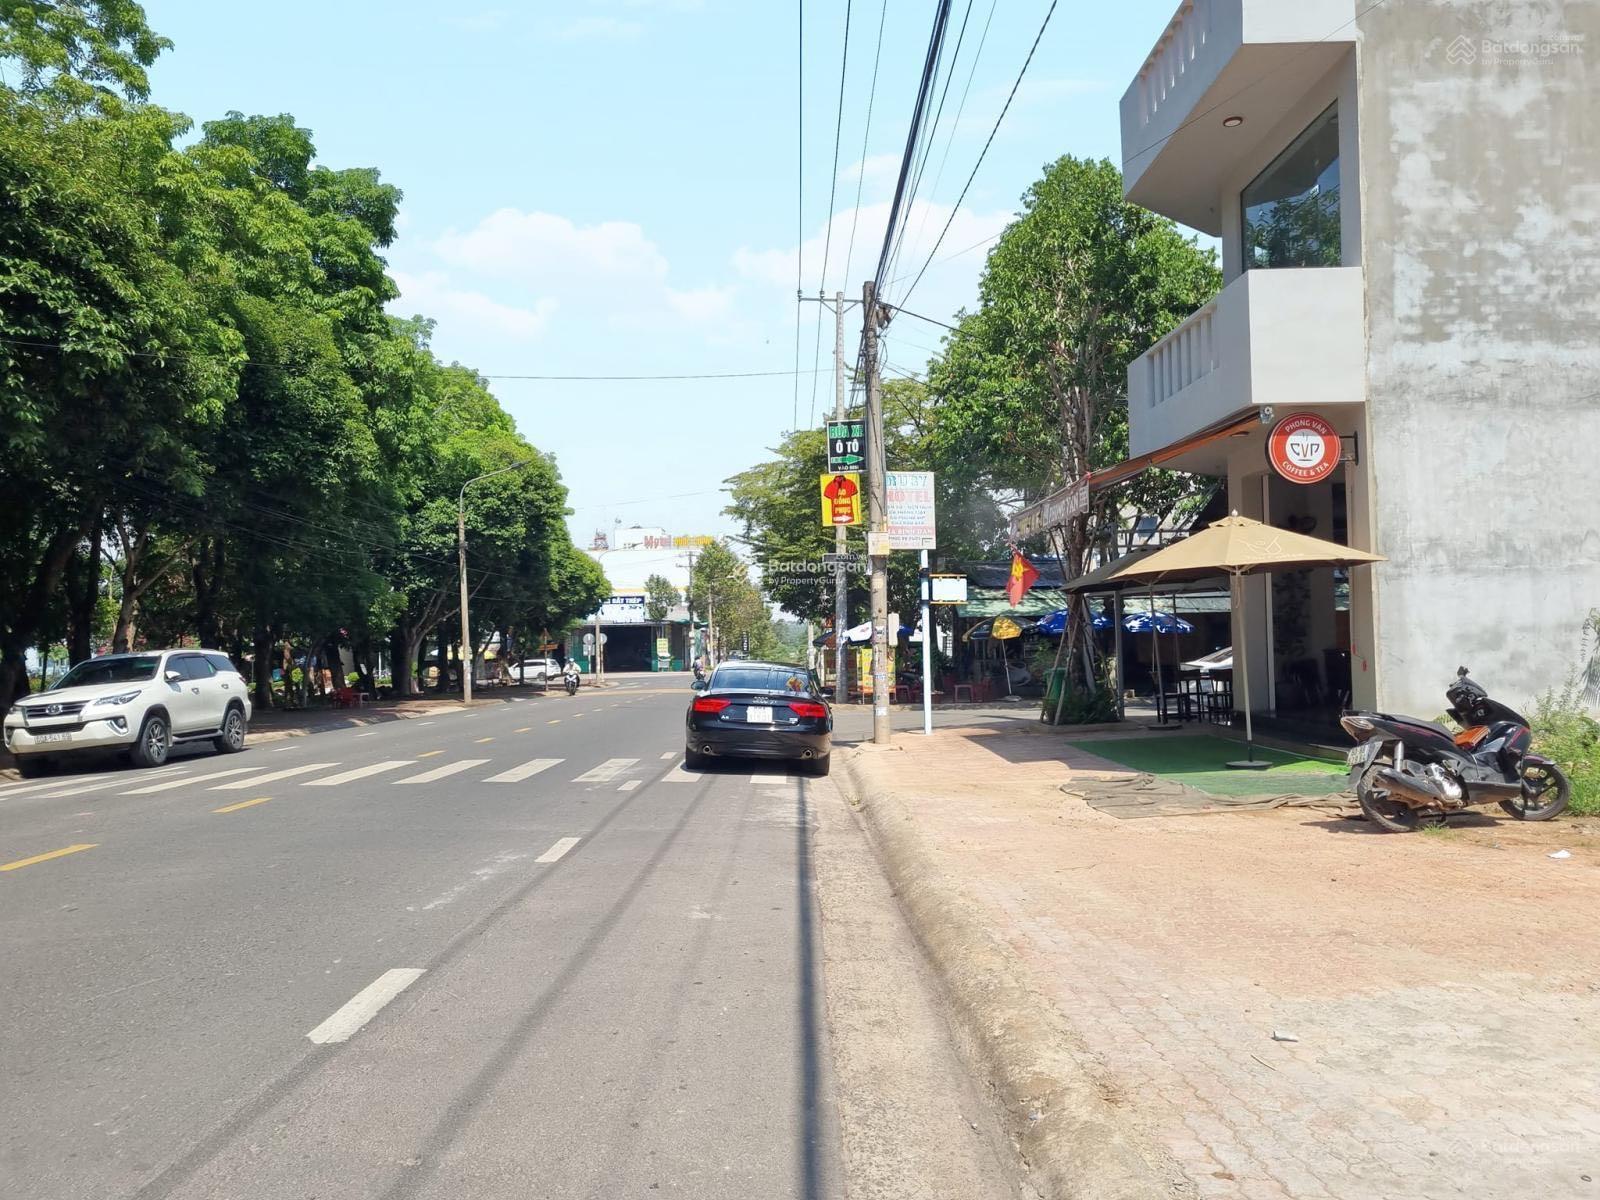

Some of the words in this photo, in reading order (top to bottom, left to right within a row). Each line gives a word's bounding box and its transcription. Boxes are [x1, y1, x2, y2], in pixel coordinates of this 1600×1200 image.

[1285, 419, 1311, 433] PHONG
[846, 438, 859, 453] TÔ
[1282, 461, 1308, 477] COFFEE
[1315, 461, 1330, 474] TEA
